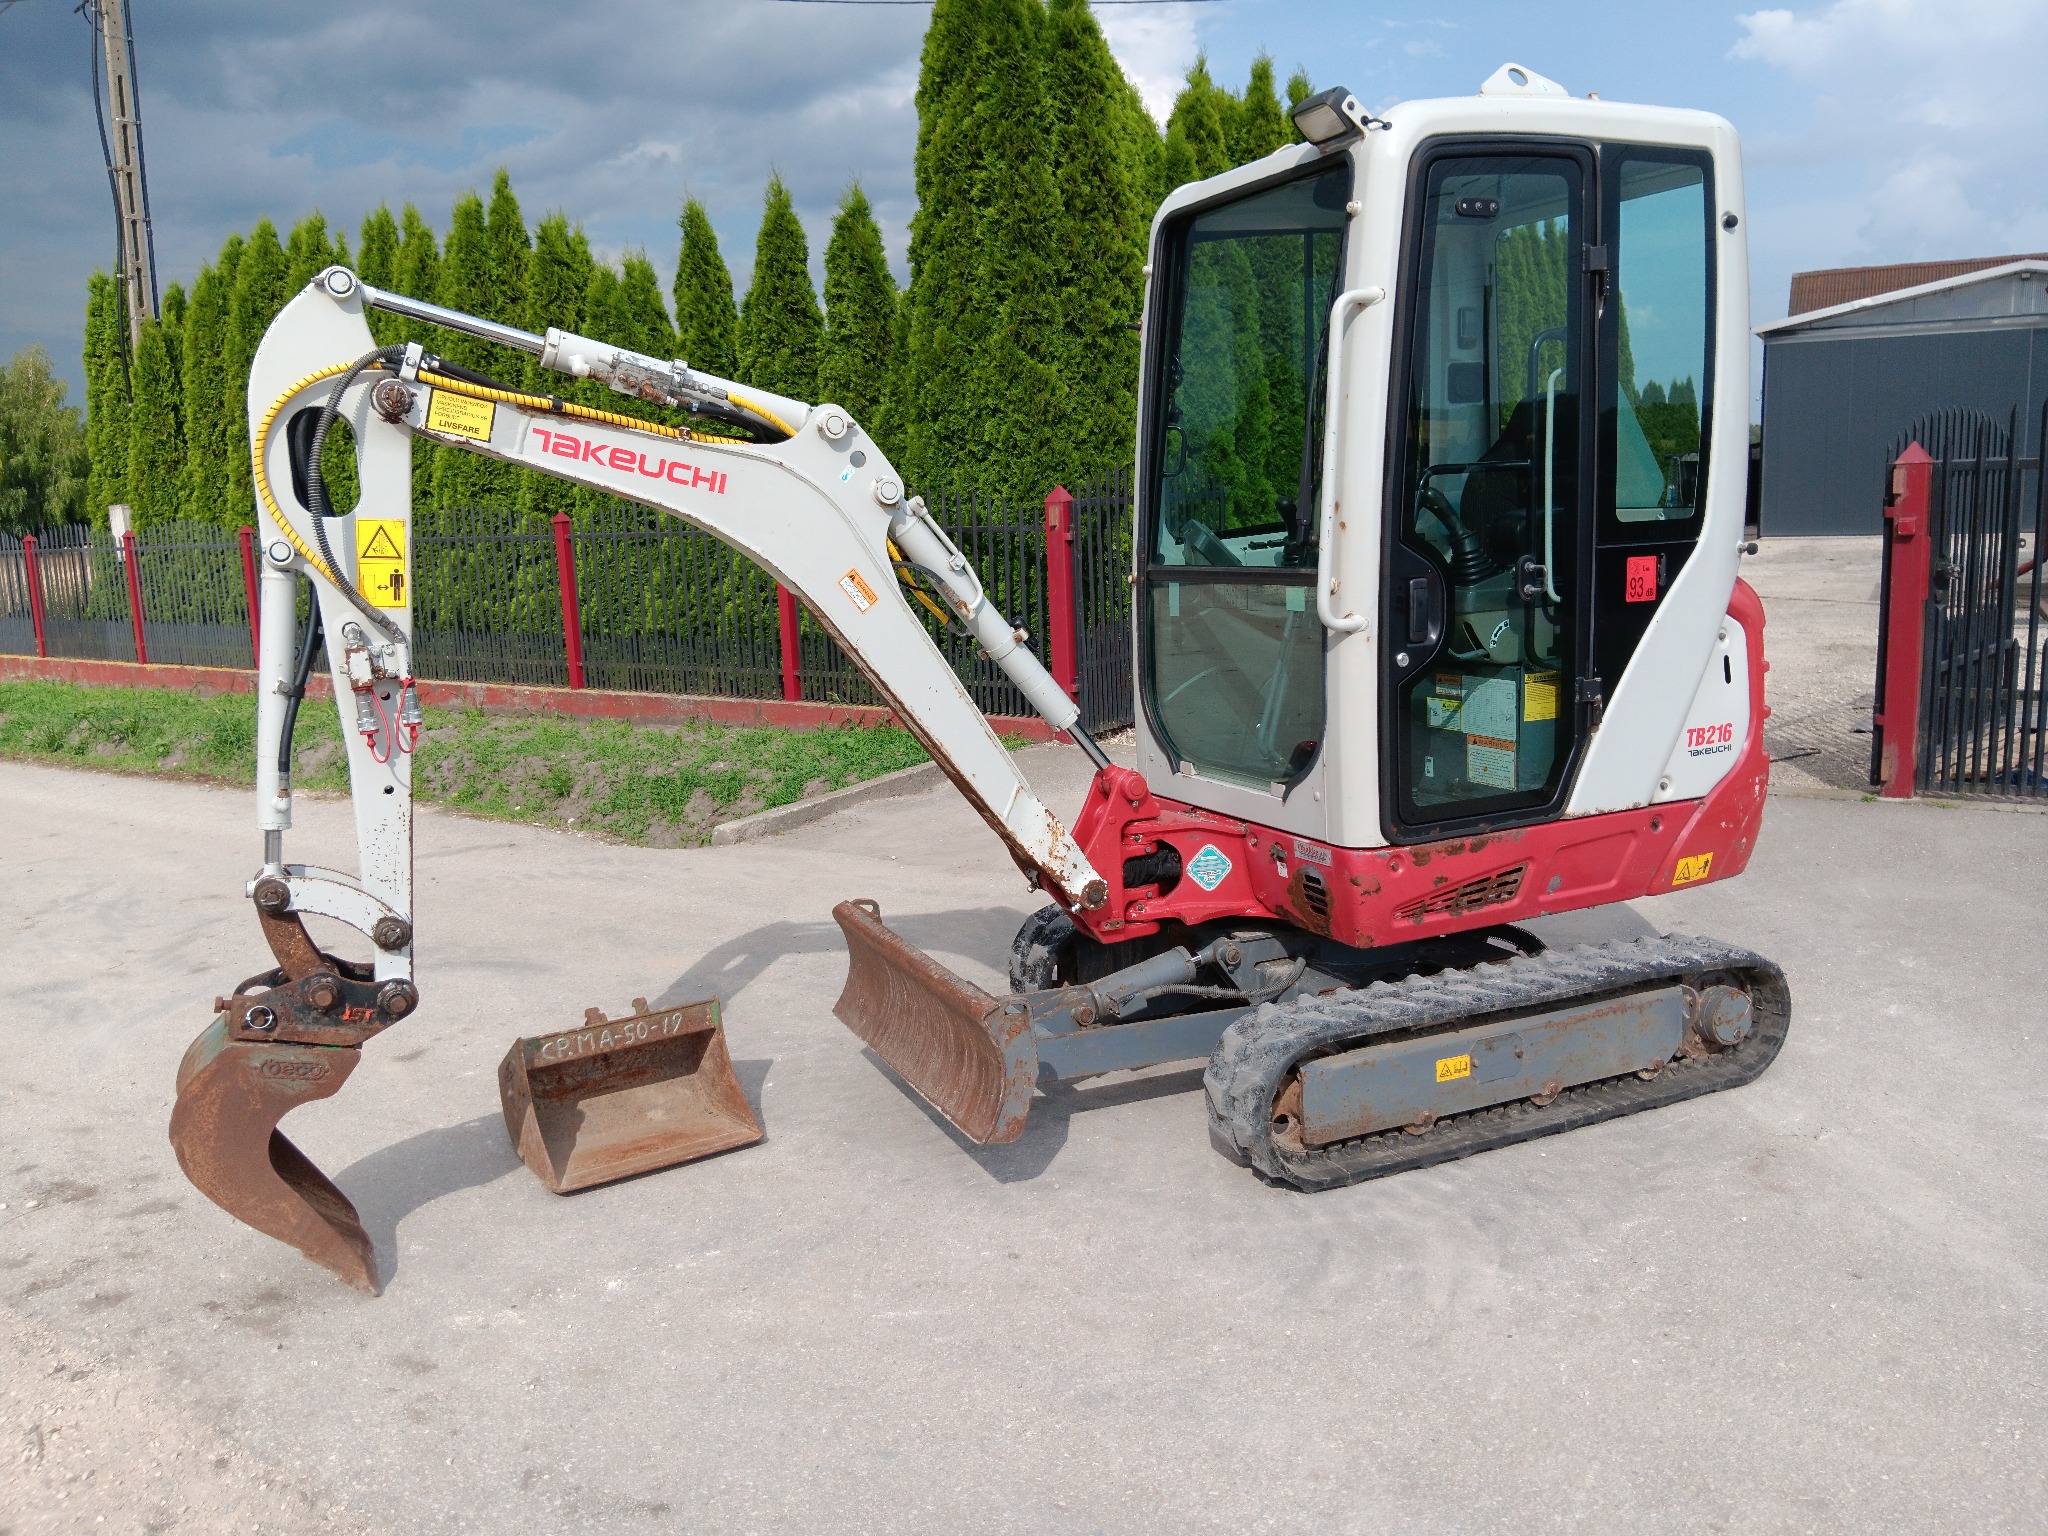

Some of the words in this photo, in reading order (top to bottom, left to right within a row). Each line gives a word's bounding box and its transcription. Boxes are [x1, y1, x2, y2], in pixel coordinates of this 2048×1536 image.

[438, 420, 480, 434] LIVSFARE
[1630, 576, 1644, 598] 93
[1645, 587, 1654, 597] dB
[1686, 722, 1733, 748] TB216
